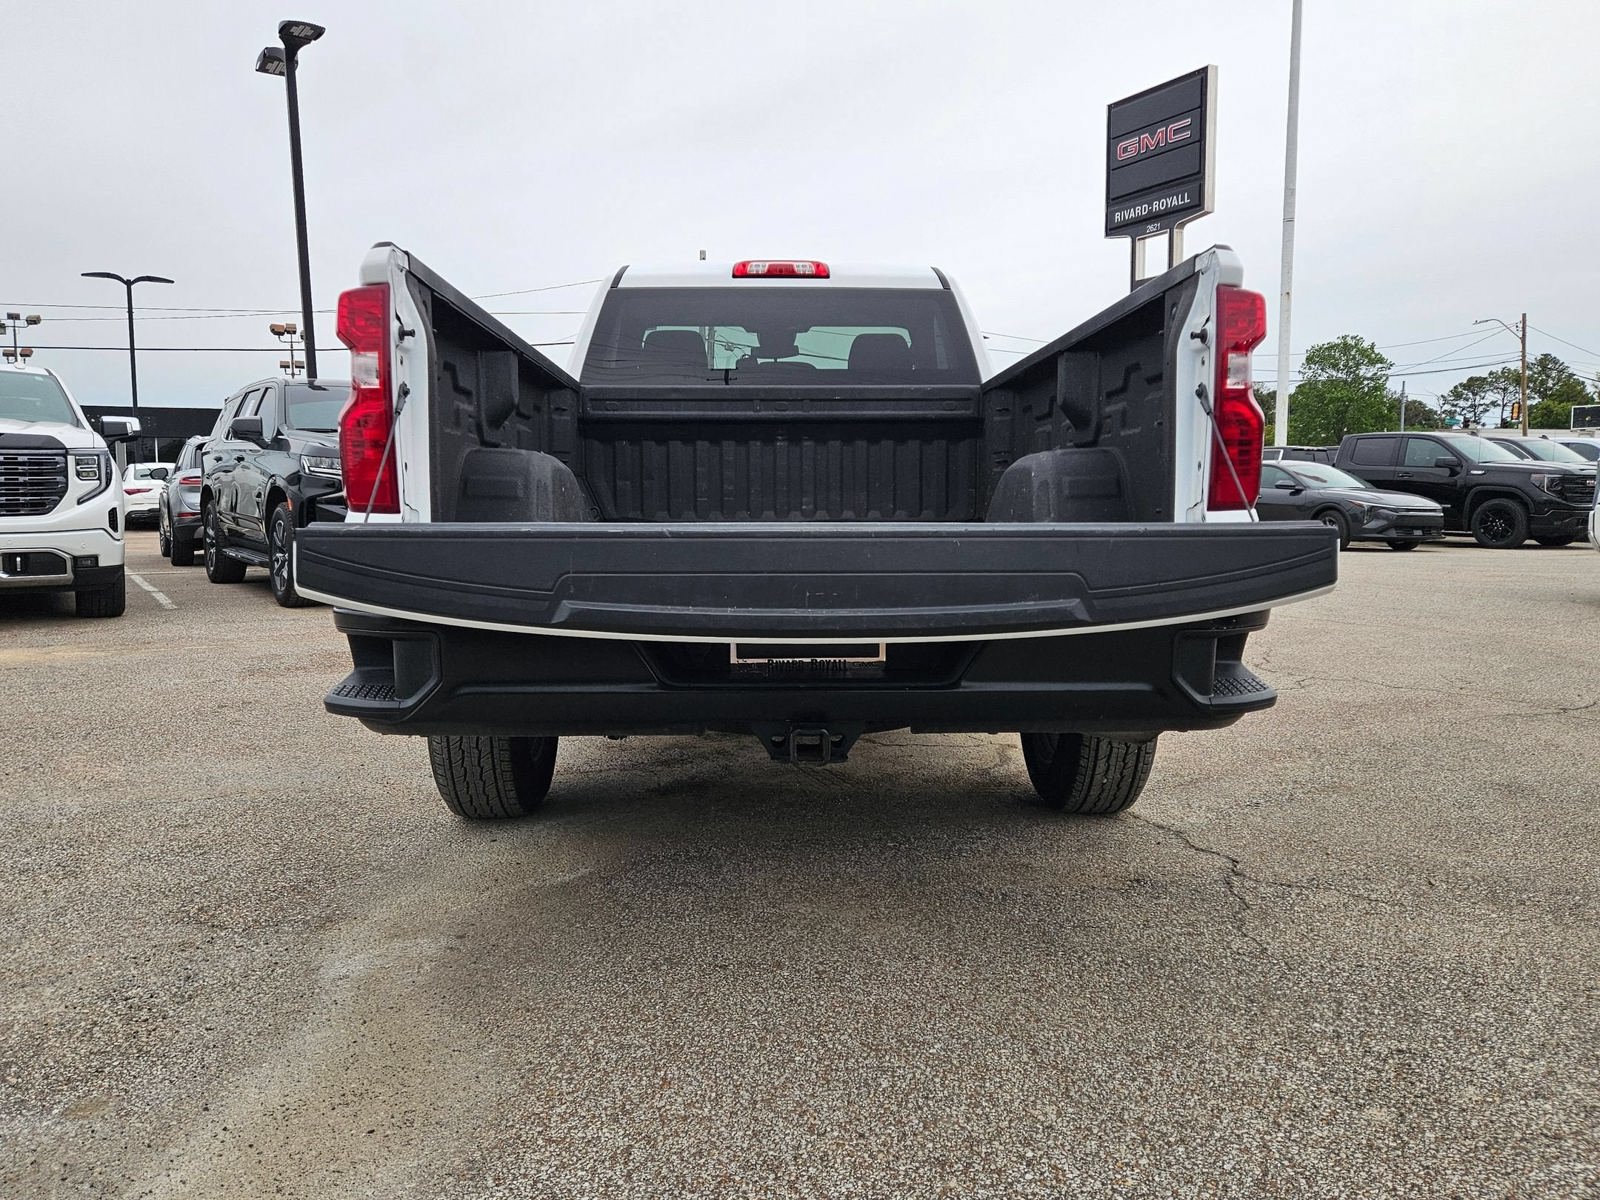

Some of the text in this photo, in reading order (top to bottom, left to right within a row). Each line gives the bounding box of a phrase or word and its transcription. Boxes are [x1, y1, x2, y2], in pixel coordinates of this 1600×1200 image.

[1117, 118, 1191, 161] GMC
[1114, 192, 1190, 223] RIVARD-ROYALL
[1146, 223, 1161, 233] 2621
